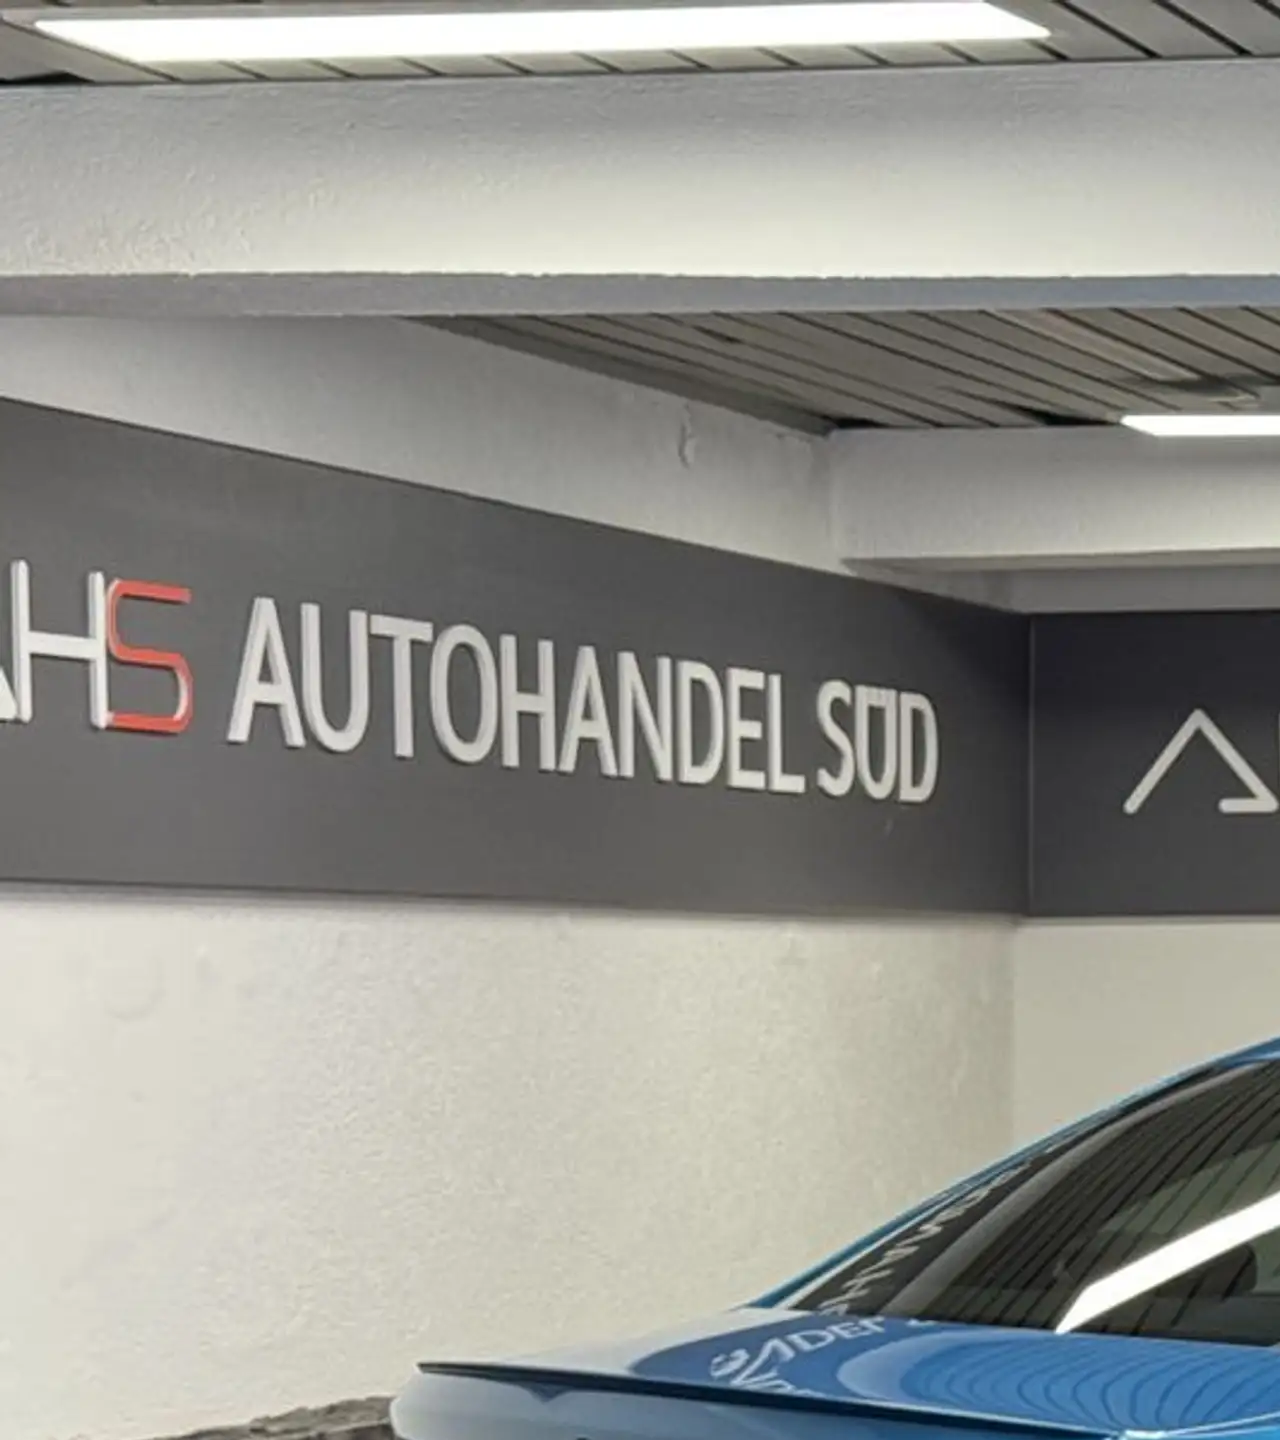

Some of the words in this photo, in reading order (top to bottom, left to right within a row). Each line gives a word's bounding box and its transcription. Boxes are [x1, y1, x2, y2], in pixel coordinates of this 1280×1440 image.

[0, 559, 192, 733] HS
[227, 597, 806, 794] AUTOHANDEL
[816, 680, 938, 803] SÜD
